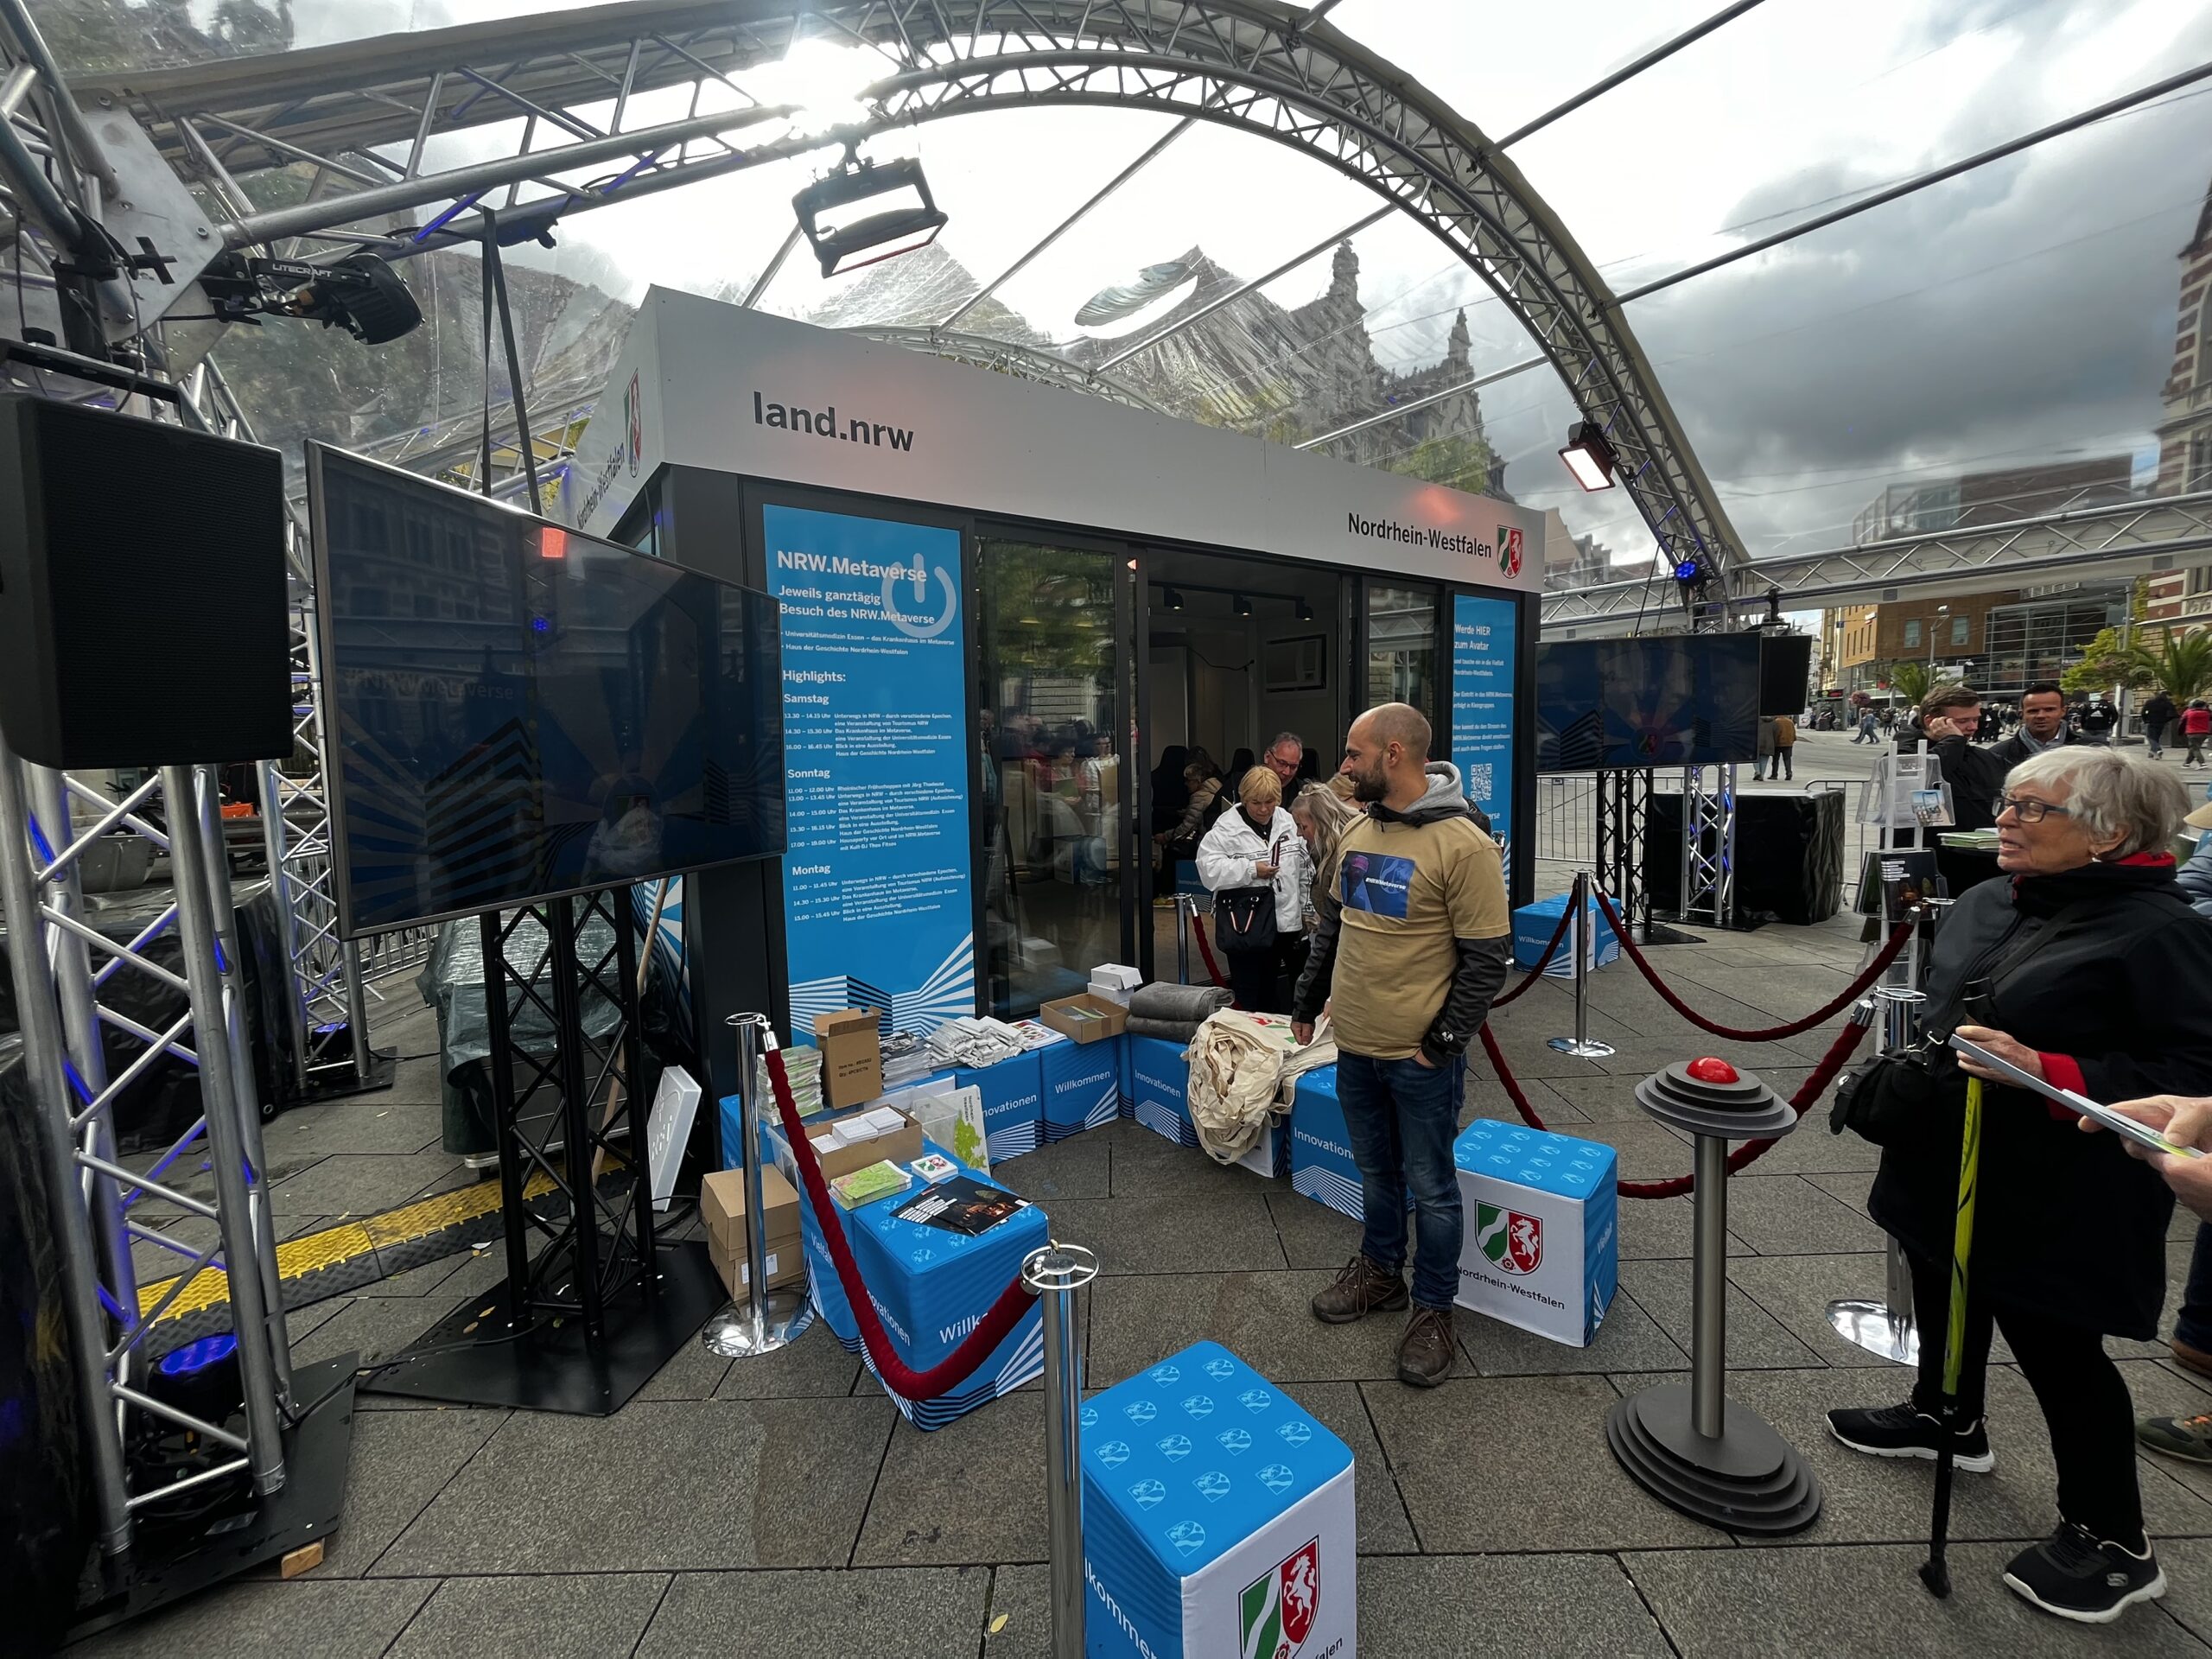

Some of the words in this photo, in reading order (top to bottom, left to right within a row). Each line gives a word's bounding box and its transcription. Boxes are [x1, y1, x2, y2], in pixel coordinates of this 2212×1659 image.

[273, 263, 332, 276] LITECRAFT
[753, 391, 913, 452] land.nrw
[1348, 512, 1491, 558] Nordrhein-Westfalen
[778, 550, 927, 582] NRW.Metaverse
[779, 585, 822, 600] Jeweils
[825, 589, 881, 605] ganztägig
[779, 603, 823, 617] Besuch
[827, 607, 848, 619] des
[850, 608, 935, 624] NRW.Metaverse
[785, 631, 845, 640] Universitätsmedizin
[883, 636, 918, 645] Krankenhaus
[1455, 624, 1474, 634] Werde
[1476, 626, 1491, 636] HIER
[816, 645, 849, 653] Geschichte
[1469, 640, 1490, 650] Avatar
[783, 671, 847, 684] Highlights:
[784, 694, 830, 705] Samstag
[788, 769, 830, 778] Sonntag
[791, 864, 831, 876] Montag
[1519, 936, 1564, 949] Willkomn
[1055, 1071, 1111, 1094] Willkommen
[1135, 1070, 1180, 1099] Innovationen
[983, 1094, 1037, 1117] novationen
[1294, 1127, 1355, 1160] Innovation
[867, 1289, 911, 1346] novationen
[940, 1313, 988, 1344] Willk
[1085, 1557, 1157, 1659] lkomme
